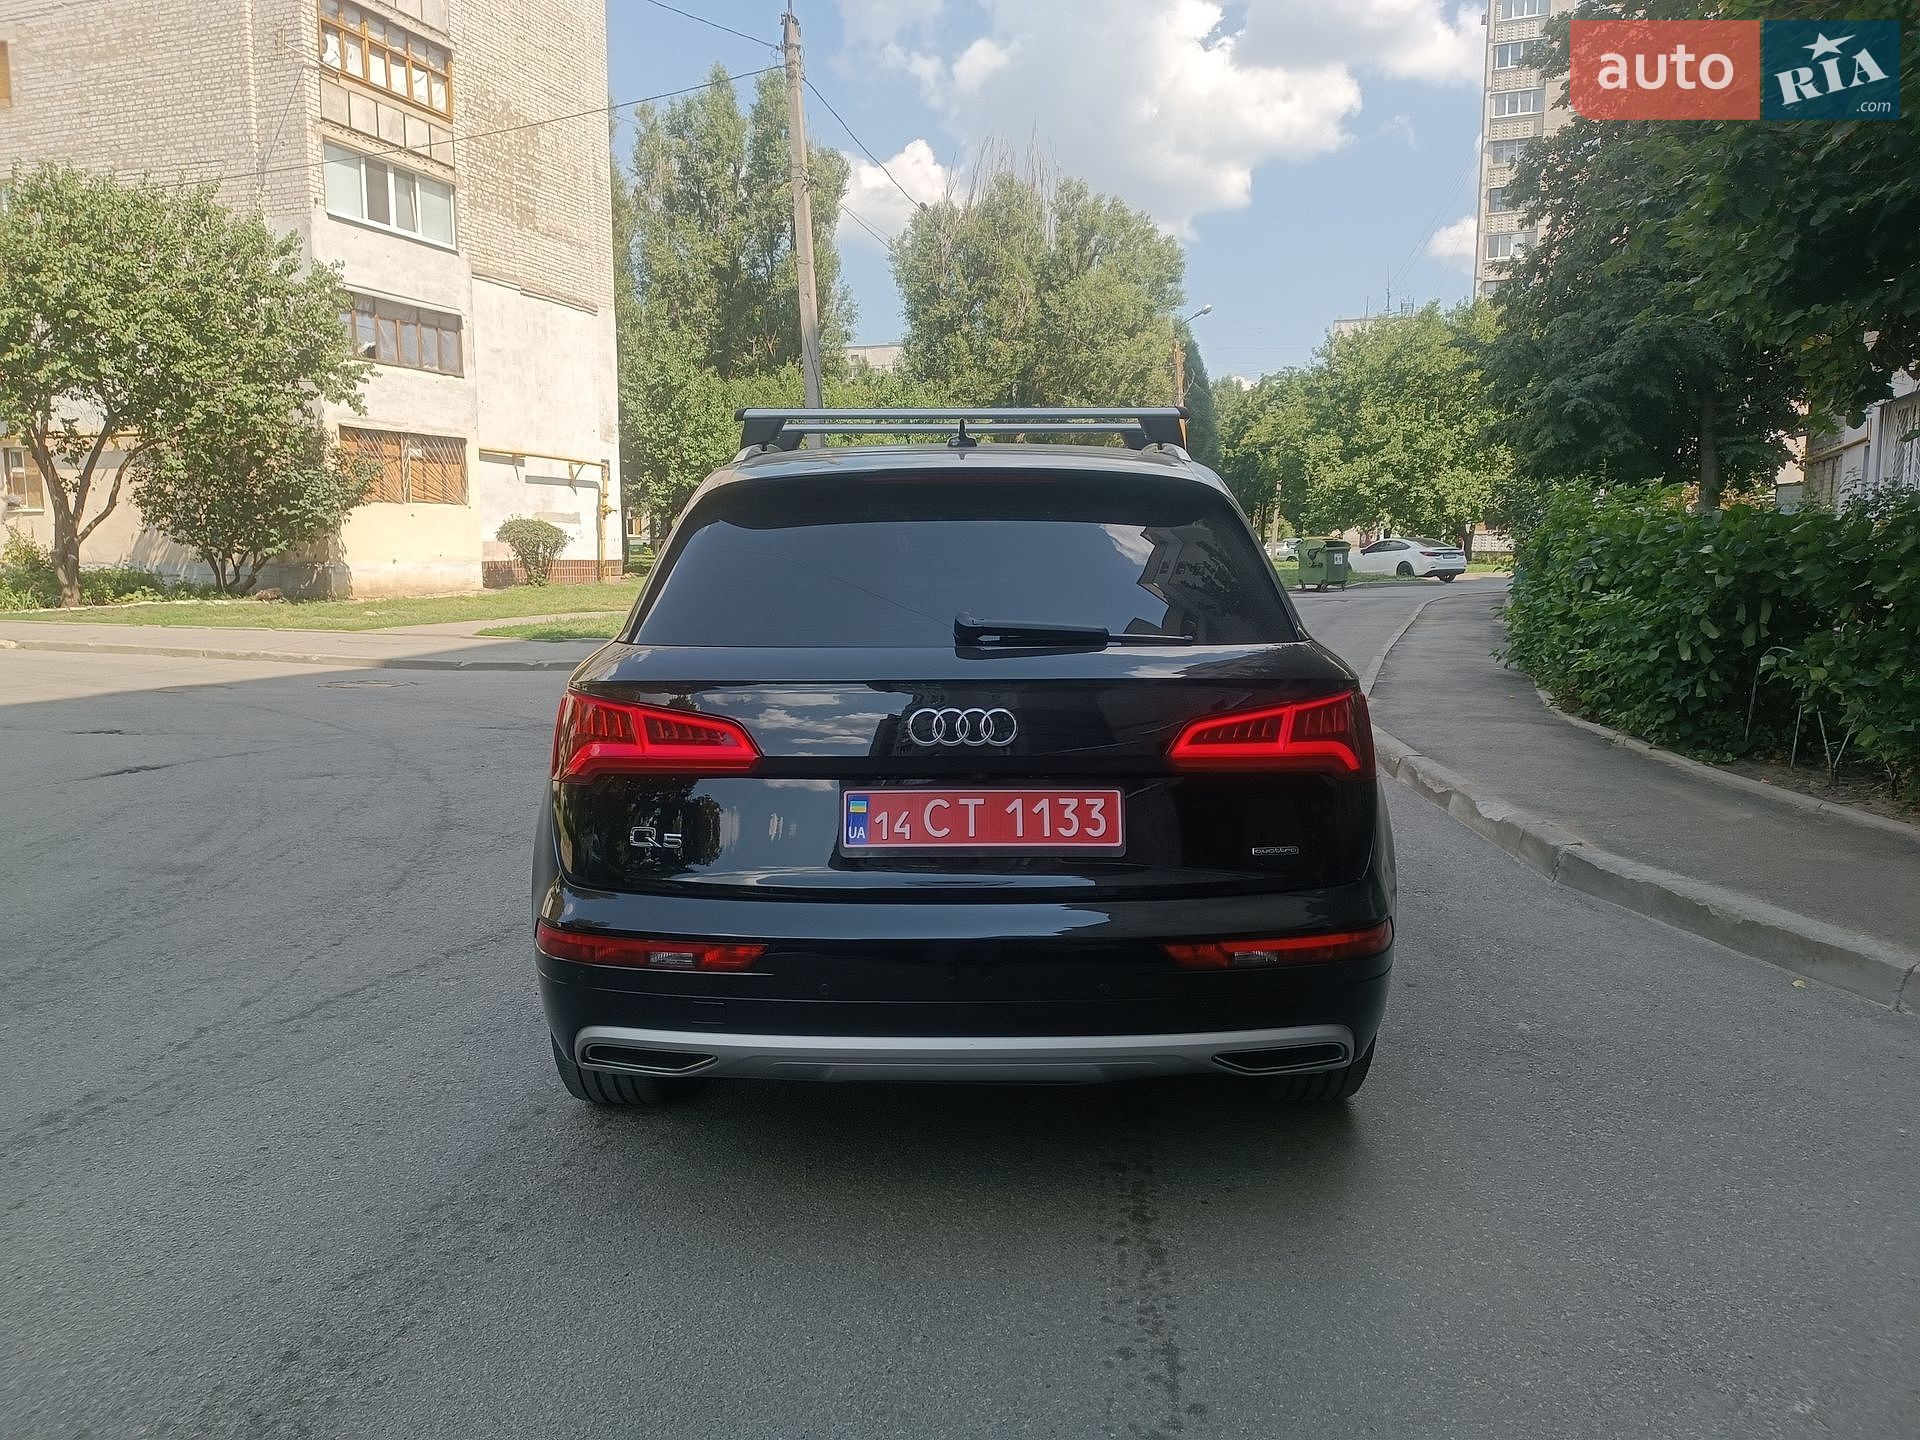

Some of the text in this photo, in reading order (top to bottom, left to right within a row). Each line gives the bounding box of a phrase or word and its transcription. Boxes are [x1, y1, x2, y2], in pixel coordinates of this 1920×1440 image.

[847, 797, 1107, 840] UA 14 CT 1133
[629, 826, 682, 849] Q5
